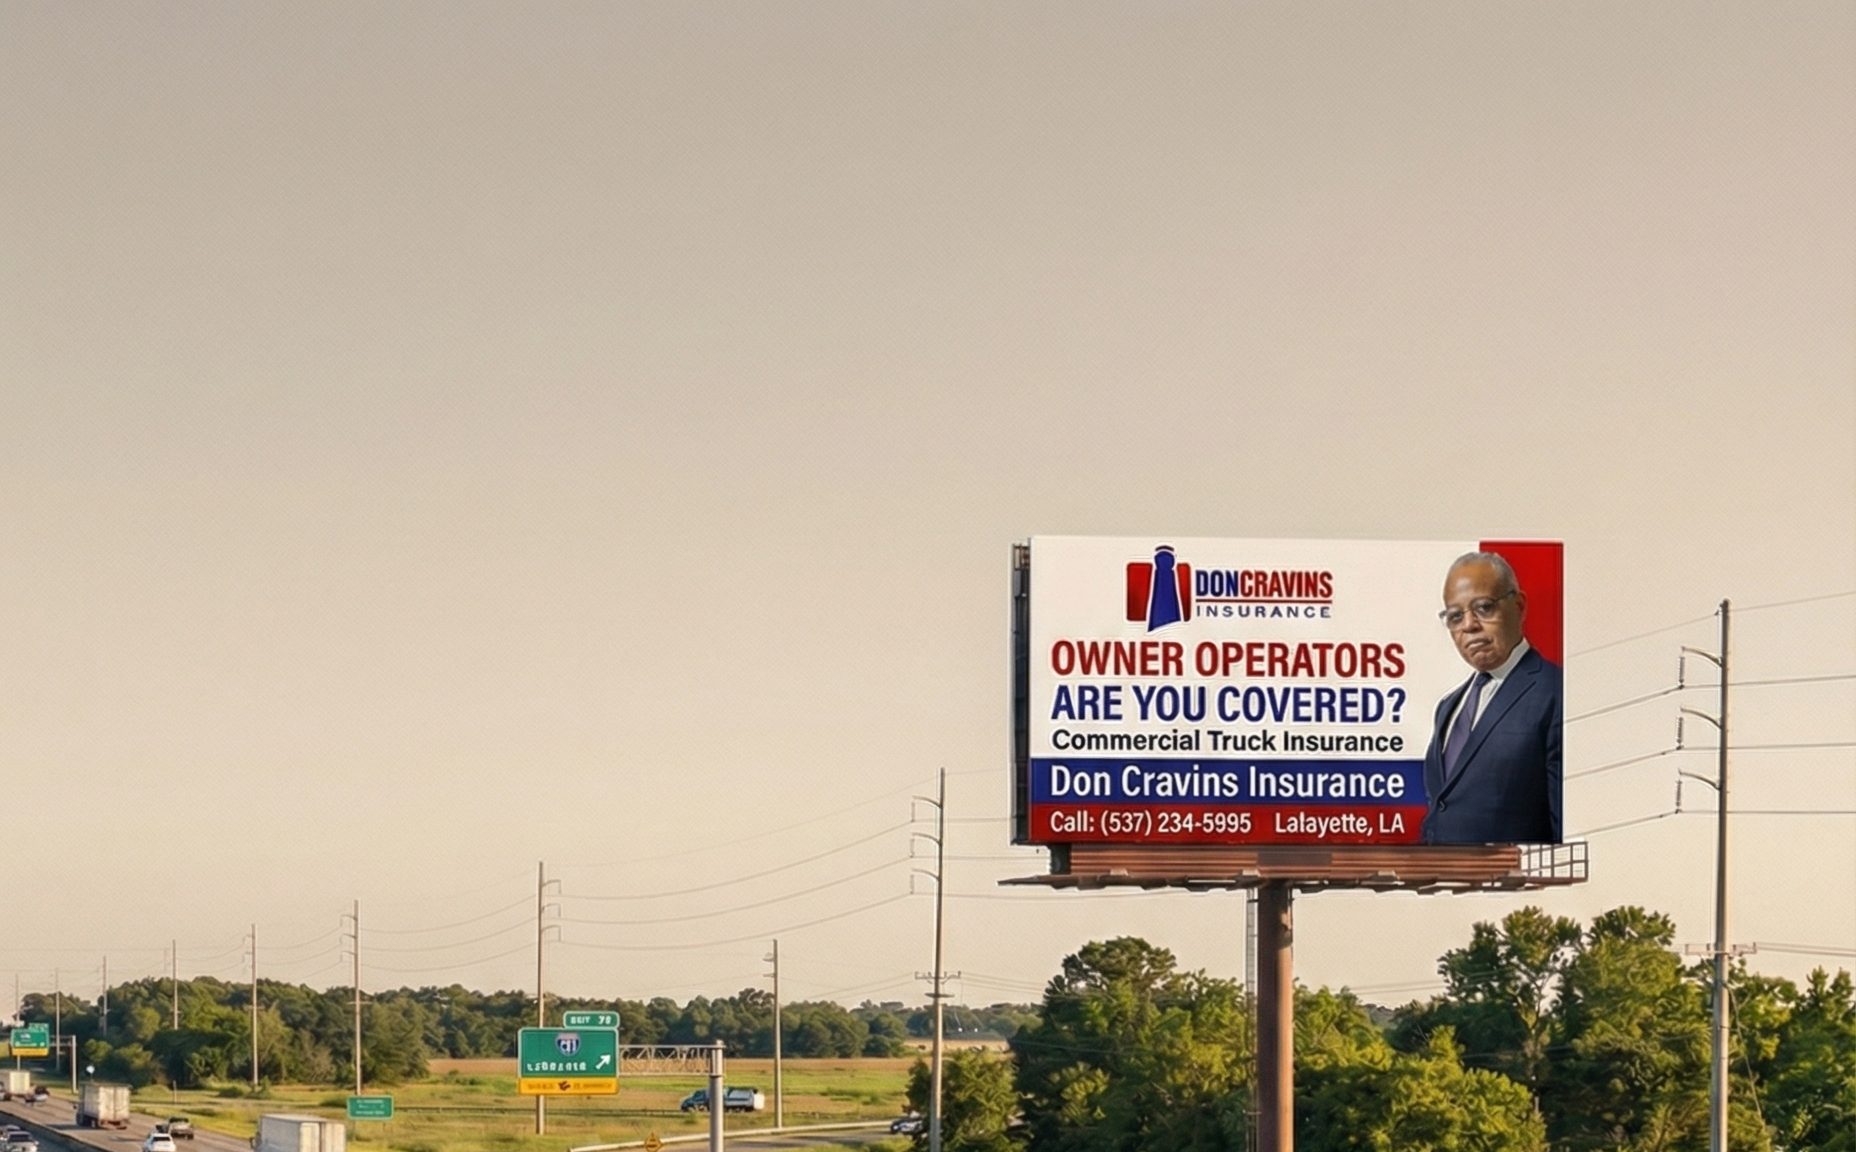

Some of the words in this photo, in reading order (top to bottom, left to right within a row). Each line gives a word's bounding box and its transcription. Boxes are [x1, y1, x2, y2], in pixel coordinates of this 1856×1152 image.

[1196, 605, 1331, 618] INSURANCE
[1051, 641, 1183, 676] OWNER
[1195, 641, 1405, 678] OPERATORS
[1051, 685, 1122, 720] ARE
[1132, 686, 1206, 721] YOU
[1217, 687, 1406, 723] COVERED?
[1052, 729, 1200, 750] Commercial
[1207, 730, 1276, 751] Truck
[1284, 732, 1404, 752] Insurance
[1051, 765, 1111, 796] Don
[1121, 764, 1239, 797] Cravins
[1249, 766, 1405, 797] Insurance
[1050, 810, 1095, 833] Call:
[1101, 810, 1152, 836] (537)
[1157, 812, 1252, 834] 234-5995
[1379, 813, 1405, 834] LA
